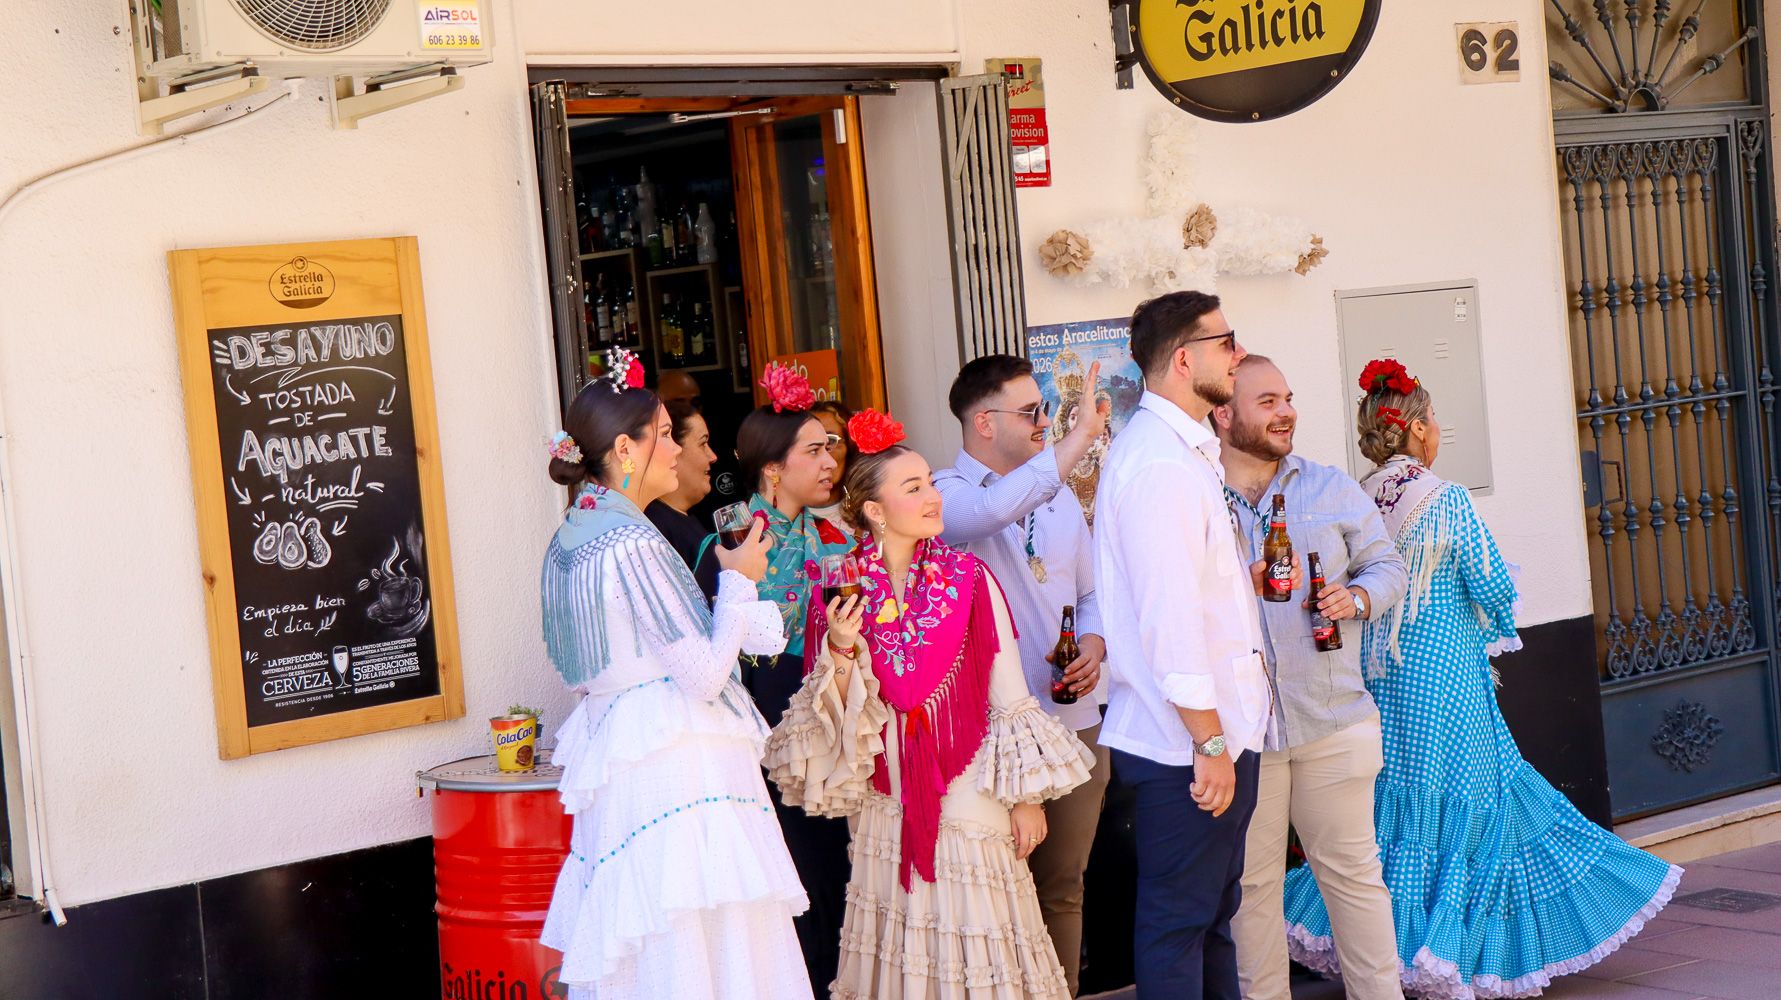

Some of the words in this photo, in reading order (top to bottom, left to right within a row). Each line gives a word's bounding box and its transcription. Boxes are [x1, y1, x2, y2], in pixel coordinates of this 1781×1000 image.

[428, 35, 443, 45] 606
[446, 35, 456, 45] 23
[458, 35, 468, 45] 39
[470, 35, 480, 45] 86
[1184, 0, 1325, 61] Galicia
[1460, 28, 1520, 75] 62
[1008, 79, 1034, 98] irect
[1010, 113, 1035, 123] arma
[1010, 125, 1044, 137] ovision
[280, 271, 324, 285] Estrella
[282, 283, 323, 297] Galicia
[228, 322, 395, 370] DESAYUNO
[1028, 333, 1059, 347] estas
[1031, 357, 1053, 374] 026
[259, 381, 355, 411] TOSTADA
[294, 412, 314, 427] DE
[238, 425, 393, 483] AGUACATE
[282, 464, 364, 504] natural
[243, 603, 309, 621] Empieza
[315, 594, 346, 610] bien
[264, 619, 279, 637] el
[284, 615, 314, 634] día
[278, 652, 322, 666] PERFECCIÓN
[353, 666, 362, 682] 5
[361, 657, 418, 673] GENERACIONES
[378, 668, 400, 677] FAMILIA
[262, 672, 334, 696] CERVEZA
[496, 726, 533, 746] ColaCao
[444, 962, 528, 1000] Galicia
